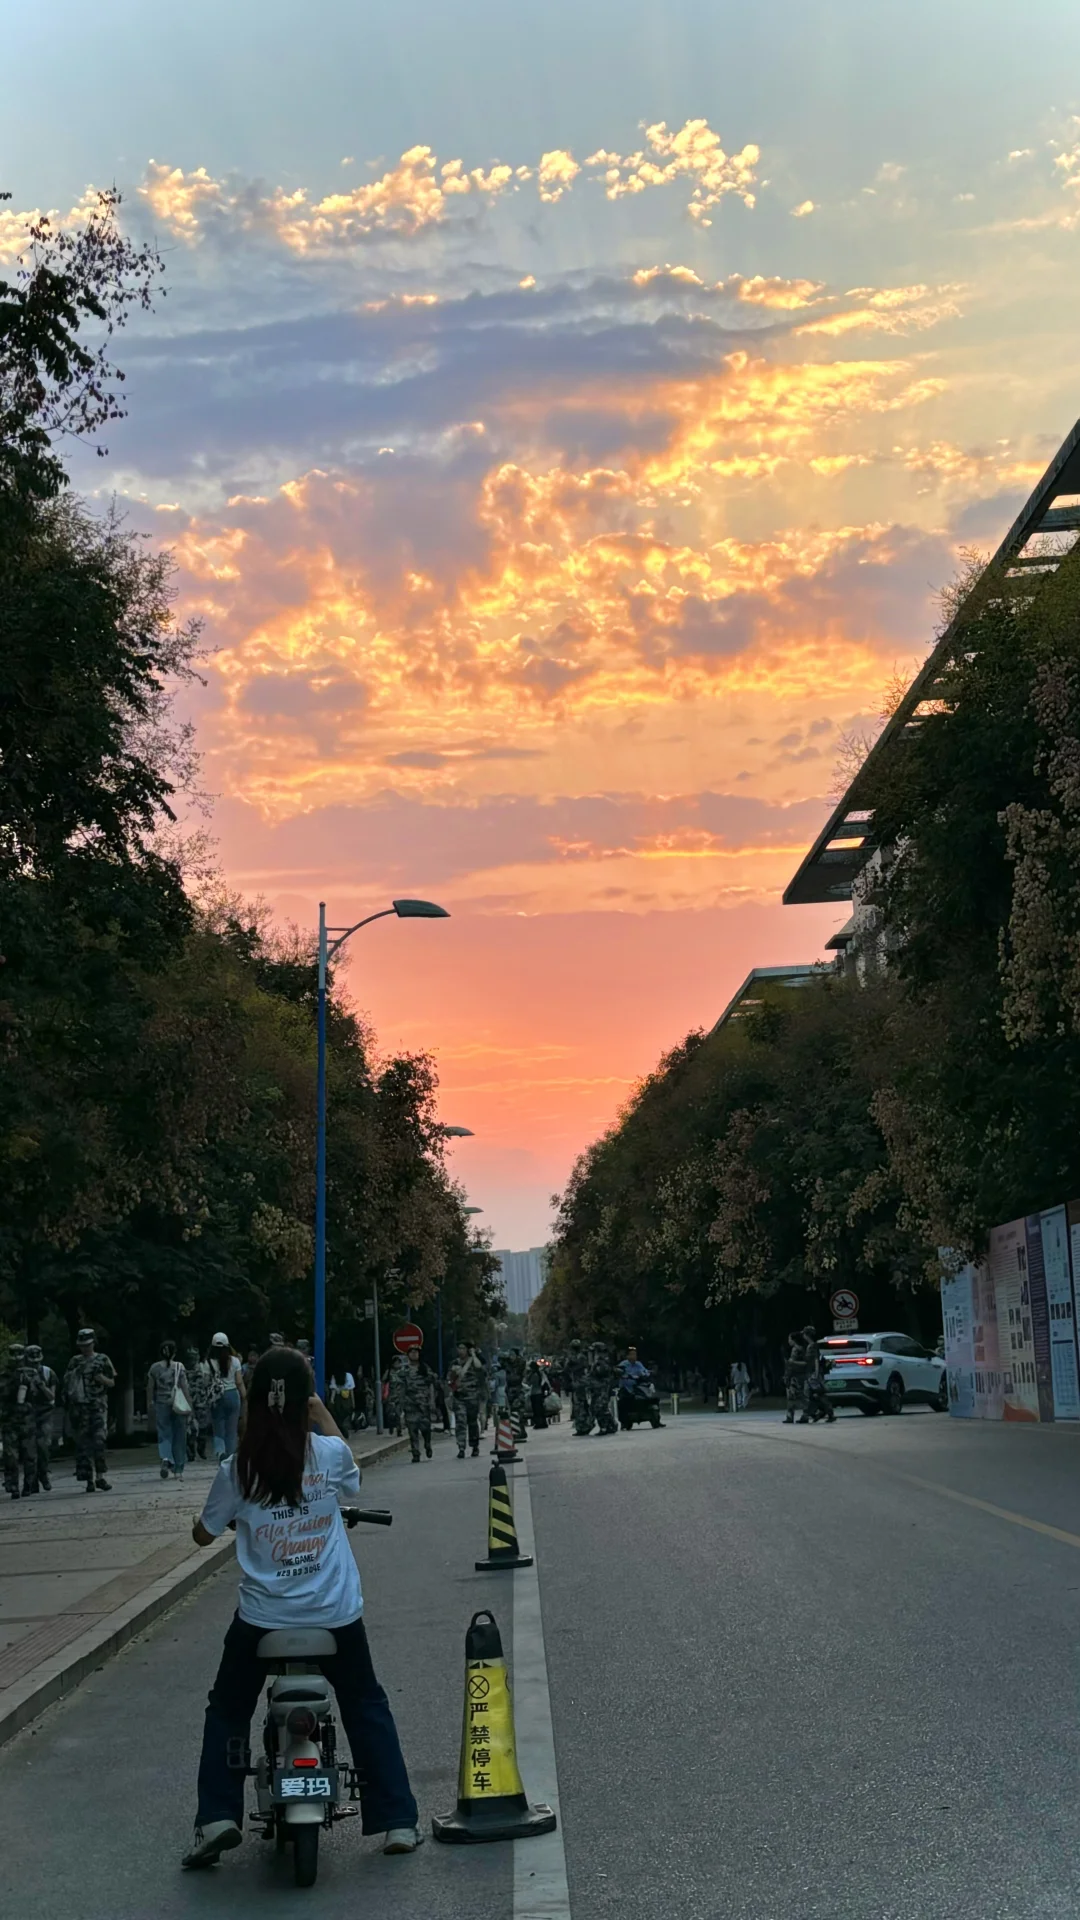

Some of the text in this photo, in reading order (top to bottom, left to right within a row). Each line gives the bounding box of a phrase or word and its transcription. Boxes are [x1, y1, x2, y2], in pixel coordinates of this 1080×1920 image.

[272, 1506, 309, 1521] THIS IS
[255, 1513, 333, 1544] Fila Fusion
[294, 1553, 315, 1565] GAME
[469, 1702, 492, 1791] 严禁停车
[281, 1776, 331, 1797] 爱玛
